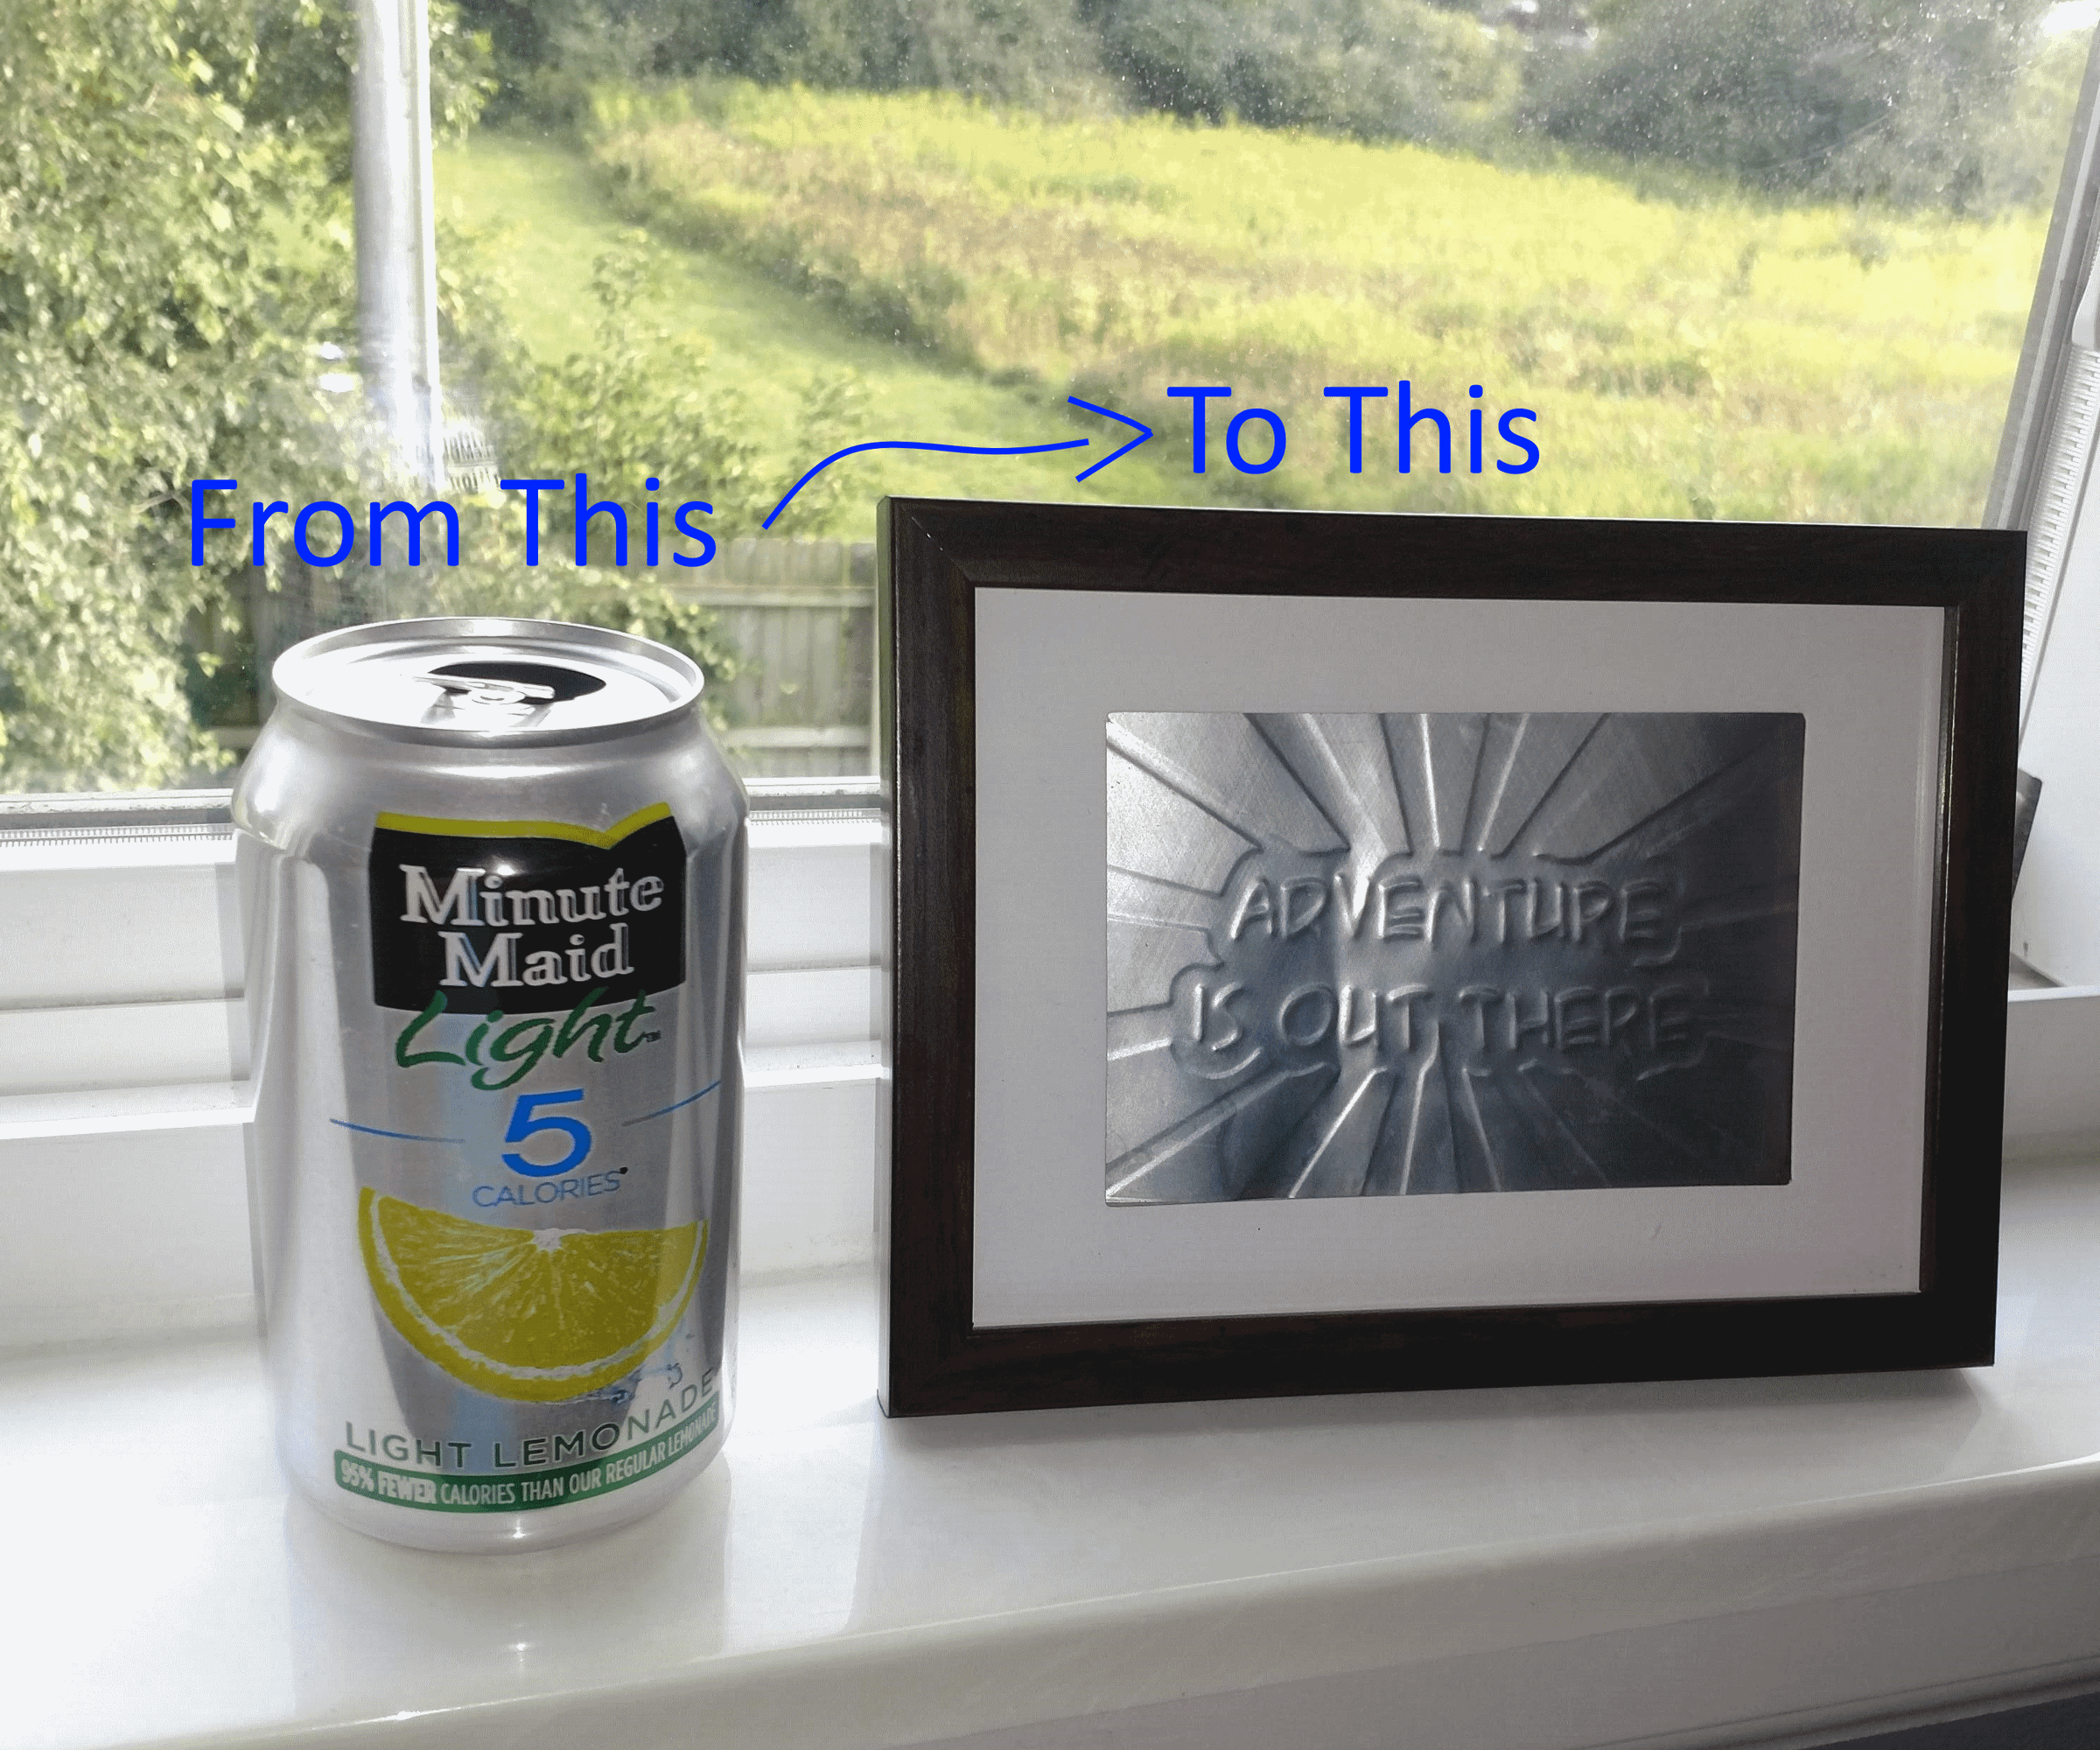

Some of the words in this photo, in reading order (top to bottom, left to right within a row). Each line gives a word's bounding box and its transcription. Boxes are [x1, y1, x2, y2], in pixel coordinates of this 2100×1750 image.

[398, 863, 665, 928] Minute
[438, 921, 635, 988] Maid
[395, 986, 656, 1091] Light
[1192, 981, 1248, 1052] IS
[1277, 980, 1432, 1050] OUT
[501, 1088, 592, 1178] 5
[346, 1421, 472, 1468] LIGHT
[494, 1368, 713, 1468] LEMONADE
[377, 1470, 437, 1505] FEWER
[440, 1483, 516, 1505] CALORIES
[520, 1475, 564, 1502] THAN
[569, 1467, 602, 1494] OUR
[606, 1442, 667, 1485] REGULAR
